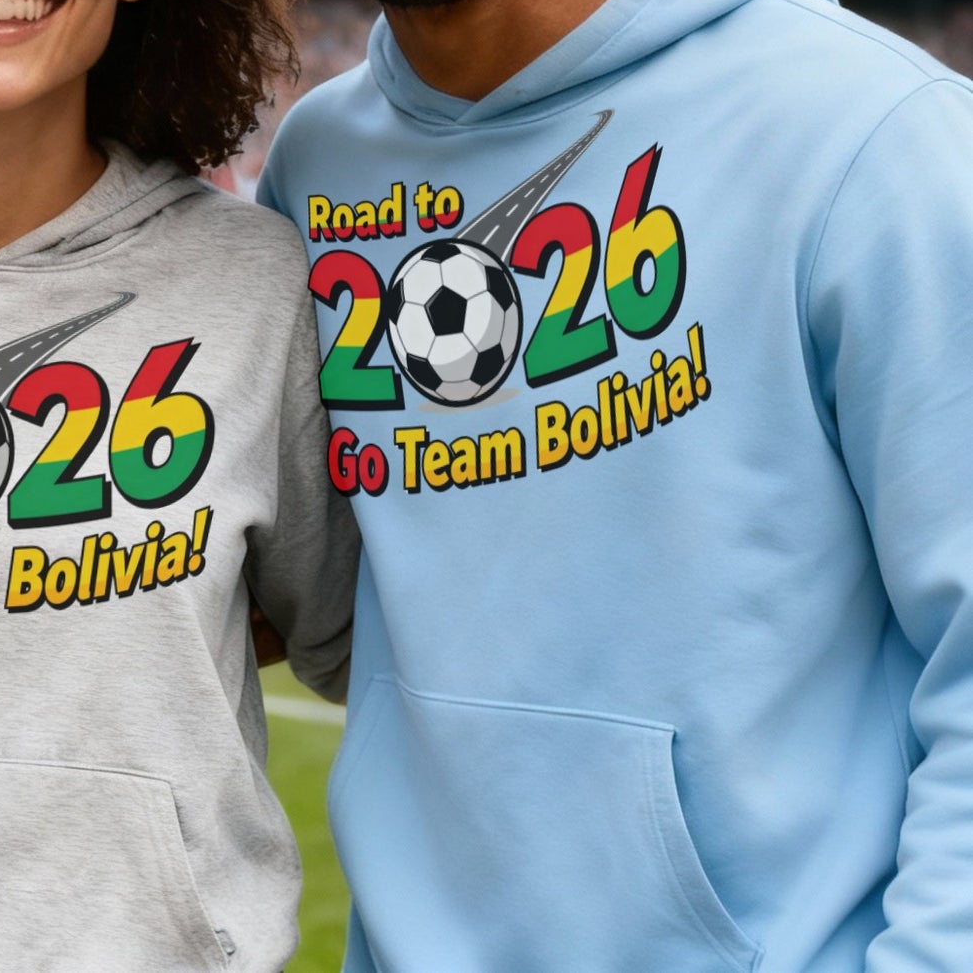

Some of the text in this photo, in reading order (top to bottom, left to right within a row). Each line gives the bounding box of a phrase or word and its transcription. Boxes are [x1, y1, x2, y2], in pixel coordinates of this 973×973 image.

[308, 181, 465, 243] Road to
[327, 321, 712, 497] Go Team Bolivia!
[4, 505, 214, 614] Bolivia!
